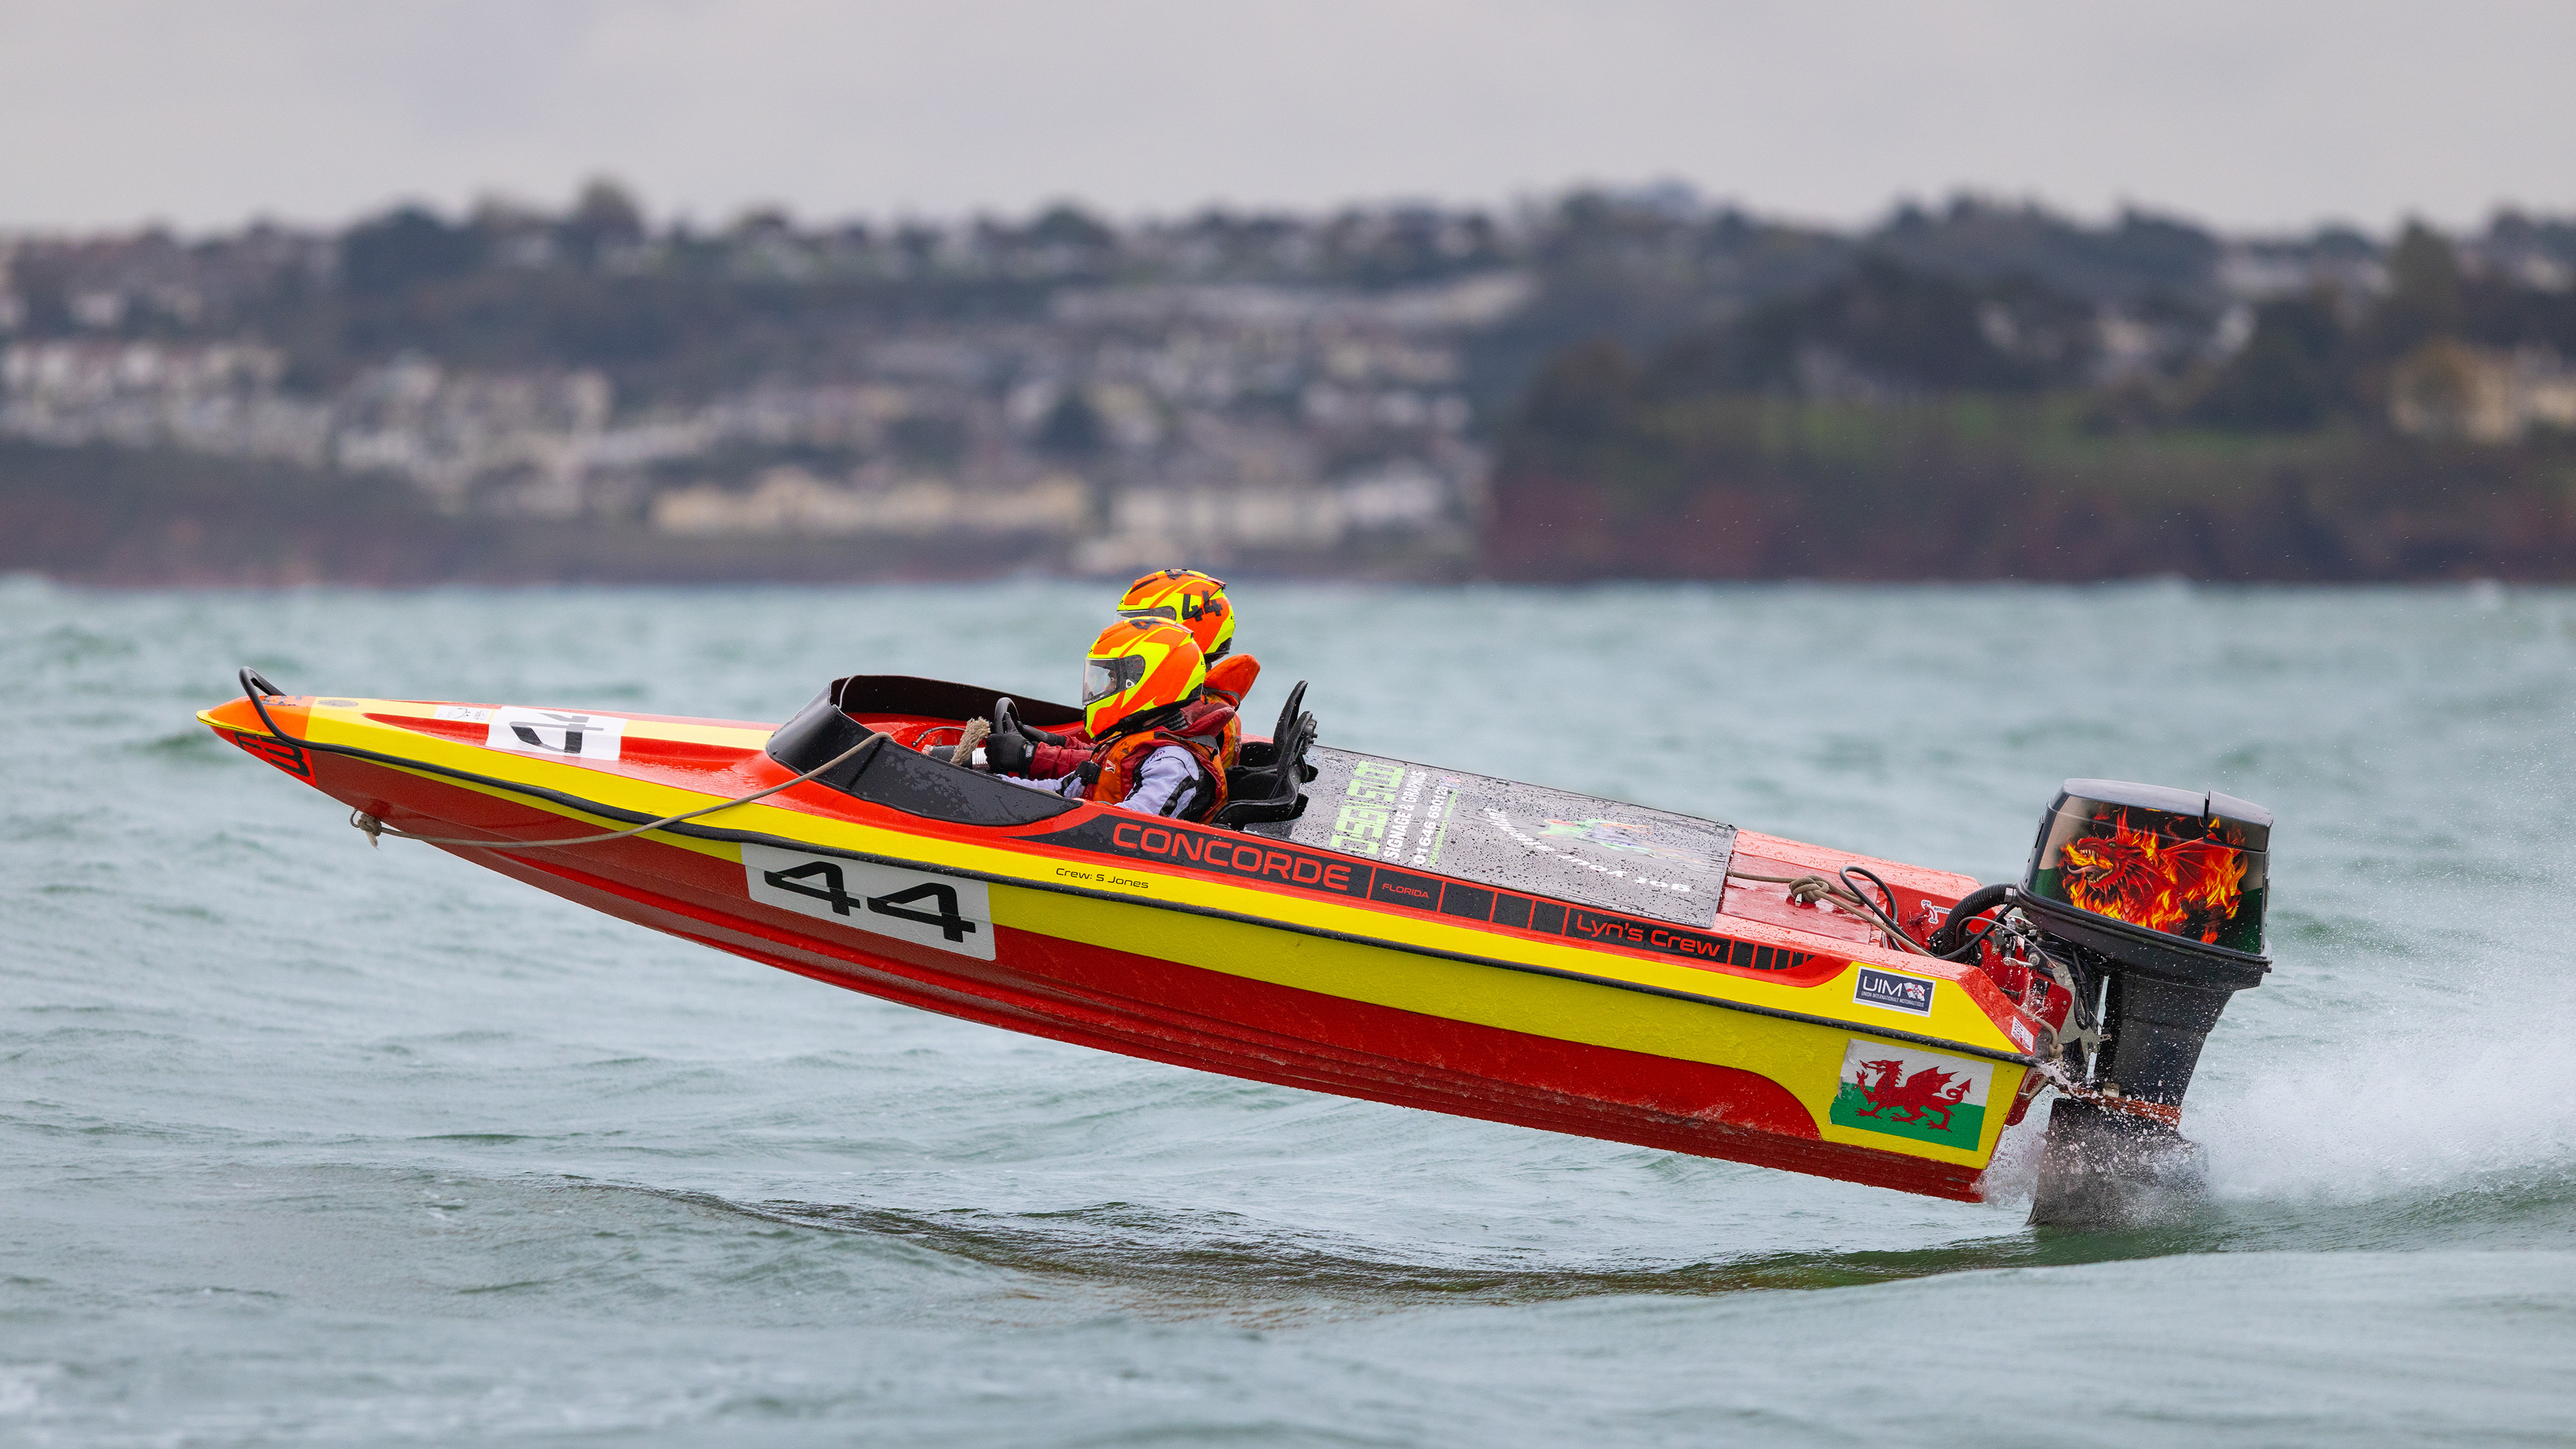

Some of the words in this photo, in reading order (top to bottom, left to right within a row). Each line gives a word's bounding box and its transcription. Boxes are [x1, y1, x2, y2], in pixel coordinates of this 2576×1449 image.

[1181, 590, 1223, 622] 44
[1401, 771, 1428, 803] GRAPHICS
[1398, 801, 1415, 812] &
[1383, 810, 1412, 859] SIGNAGE
[1413, 820, 1436, 864] 01646
[1428, 786, 1450, 818] 690123
[1112, 822, 1352, 891] CONCORDE
[1556, 855, 1629, 878] your
[1055, 868, 1093, 880] Crew:
[1095, 873, 1106, 882] S
[1107, 876, 1149, 889] Jones
[1382, 883, 1430, 899] FLORIDA
[1634, 877, 1690, 892] got
[763, 861, 976, 943] 44
[1577, 914, 1644, 943] Lyn's
[1650, 930, 1721, 957] Crew
[1861, 990, 1872, 998] UNION
[1872, 992, 1899, 1003] INTERNATIONALE
[1899, 998, 1925, 1008] MOTONAUTIQUE
[1862, 975, 1903, 997] UIM
